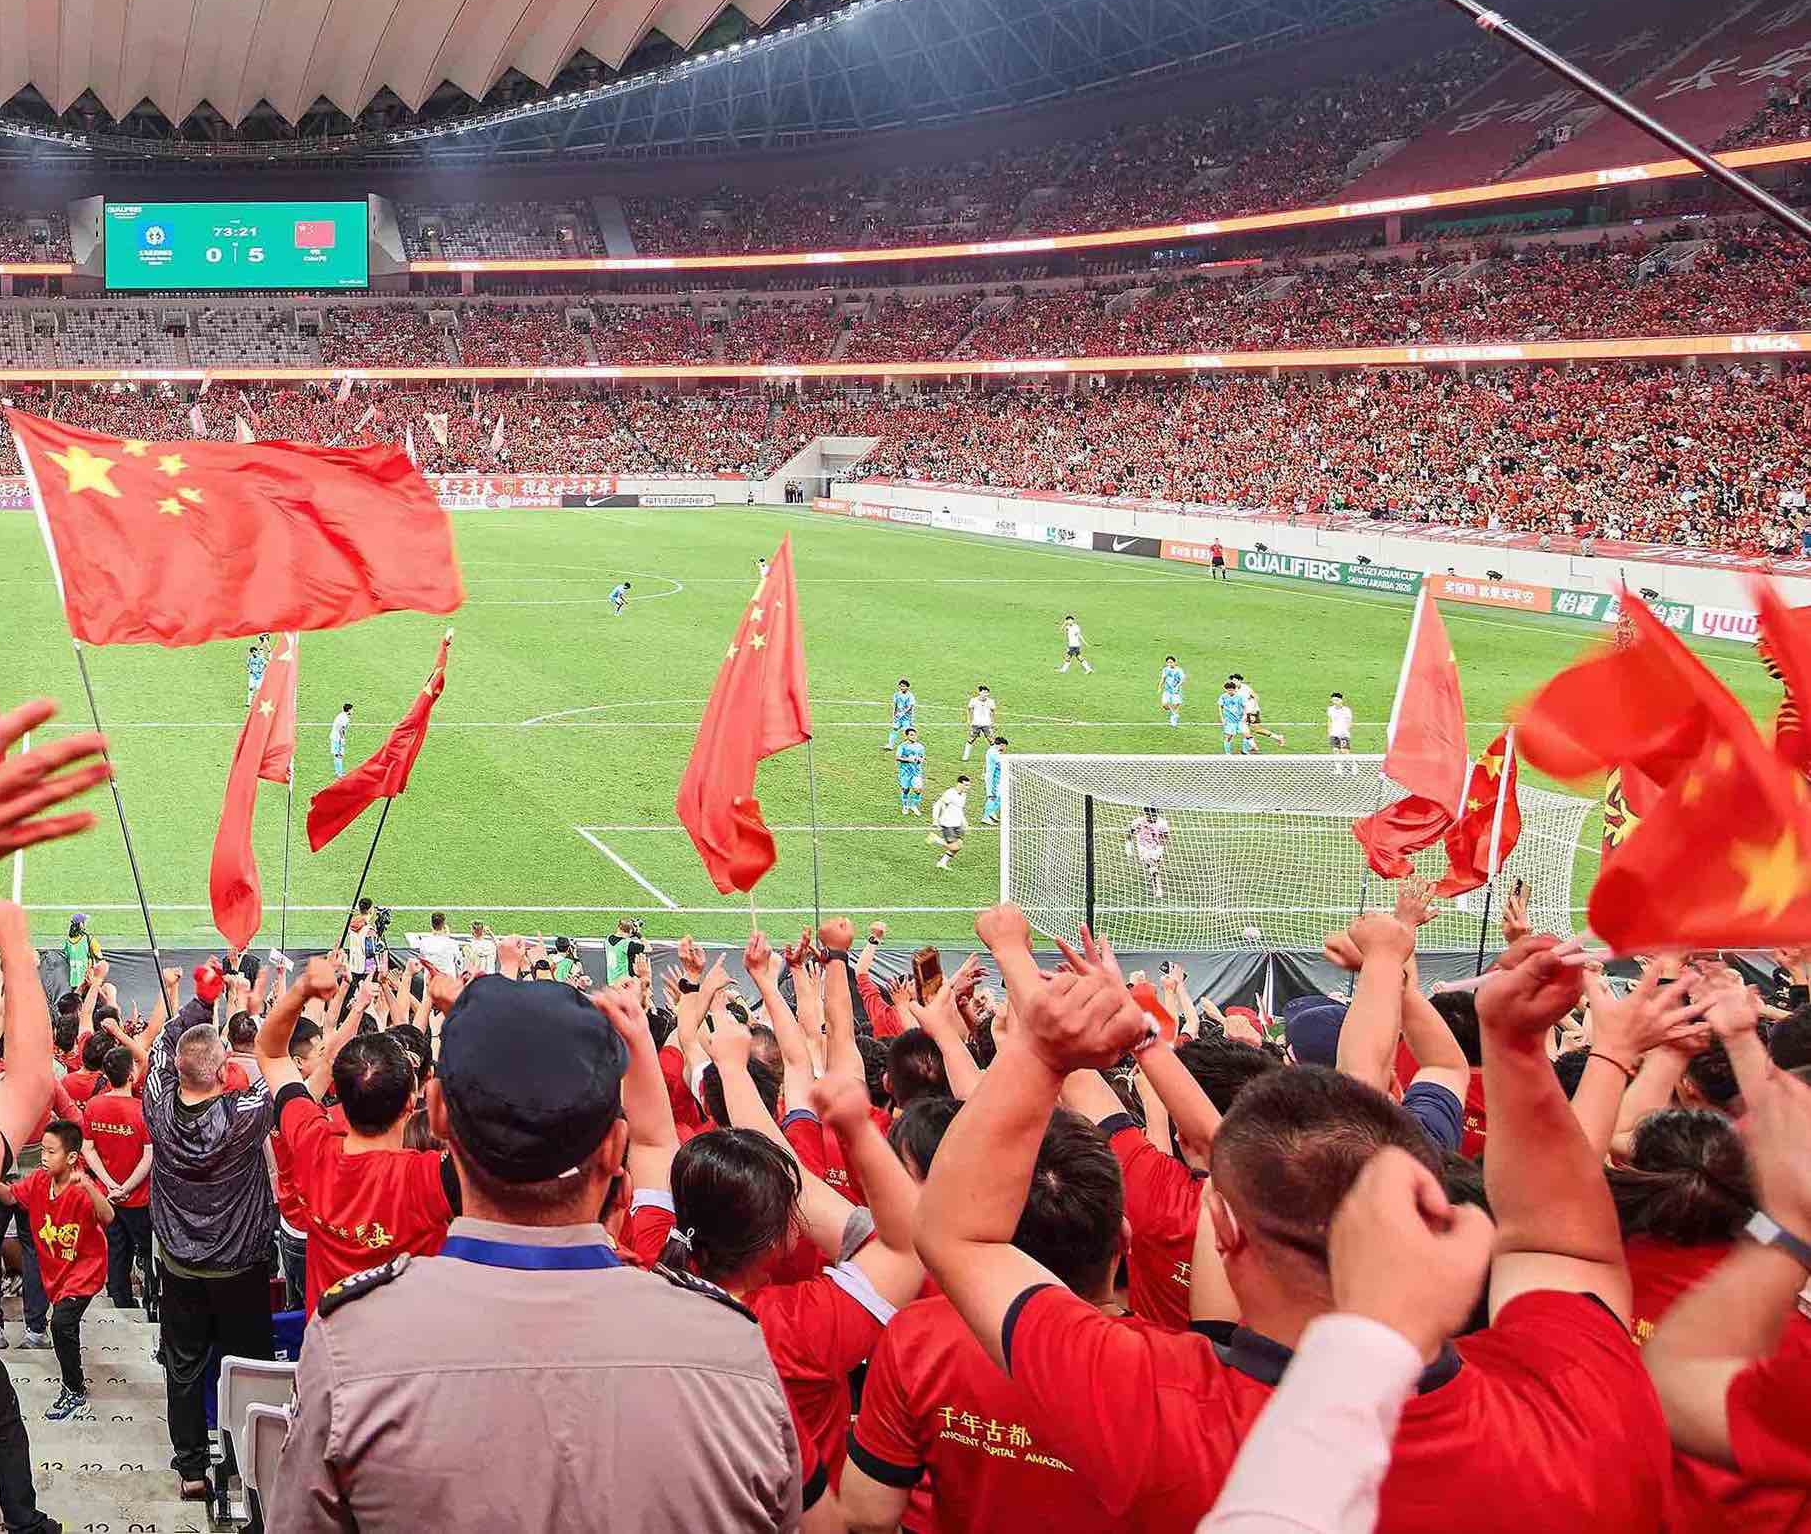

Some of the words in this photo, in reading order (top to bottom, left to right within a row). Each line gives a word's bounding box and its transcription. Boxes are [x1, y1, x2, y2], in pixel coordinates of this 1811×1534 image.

[213, 226, 258, 237] 73:21
[206, 247, 222, 263] 0
[248, 247, 265, 263] 5
[1245, 553, 1341, 582] QUALIFIERS
[1377, 568, 1400, 579] ASIAN
[1400, 571, 1417, 581] CUP
[1347, 575, 1368, 586] SAUDI
[1368, 578, 1394, 590] ARABIA
[1701, 609, 1759, 636] yuw
[938, 1406, 1032, 1448] 千年古都
[940, 1431, 980, 1448] ANCIENT
